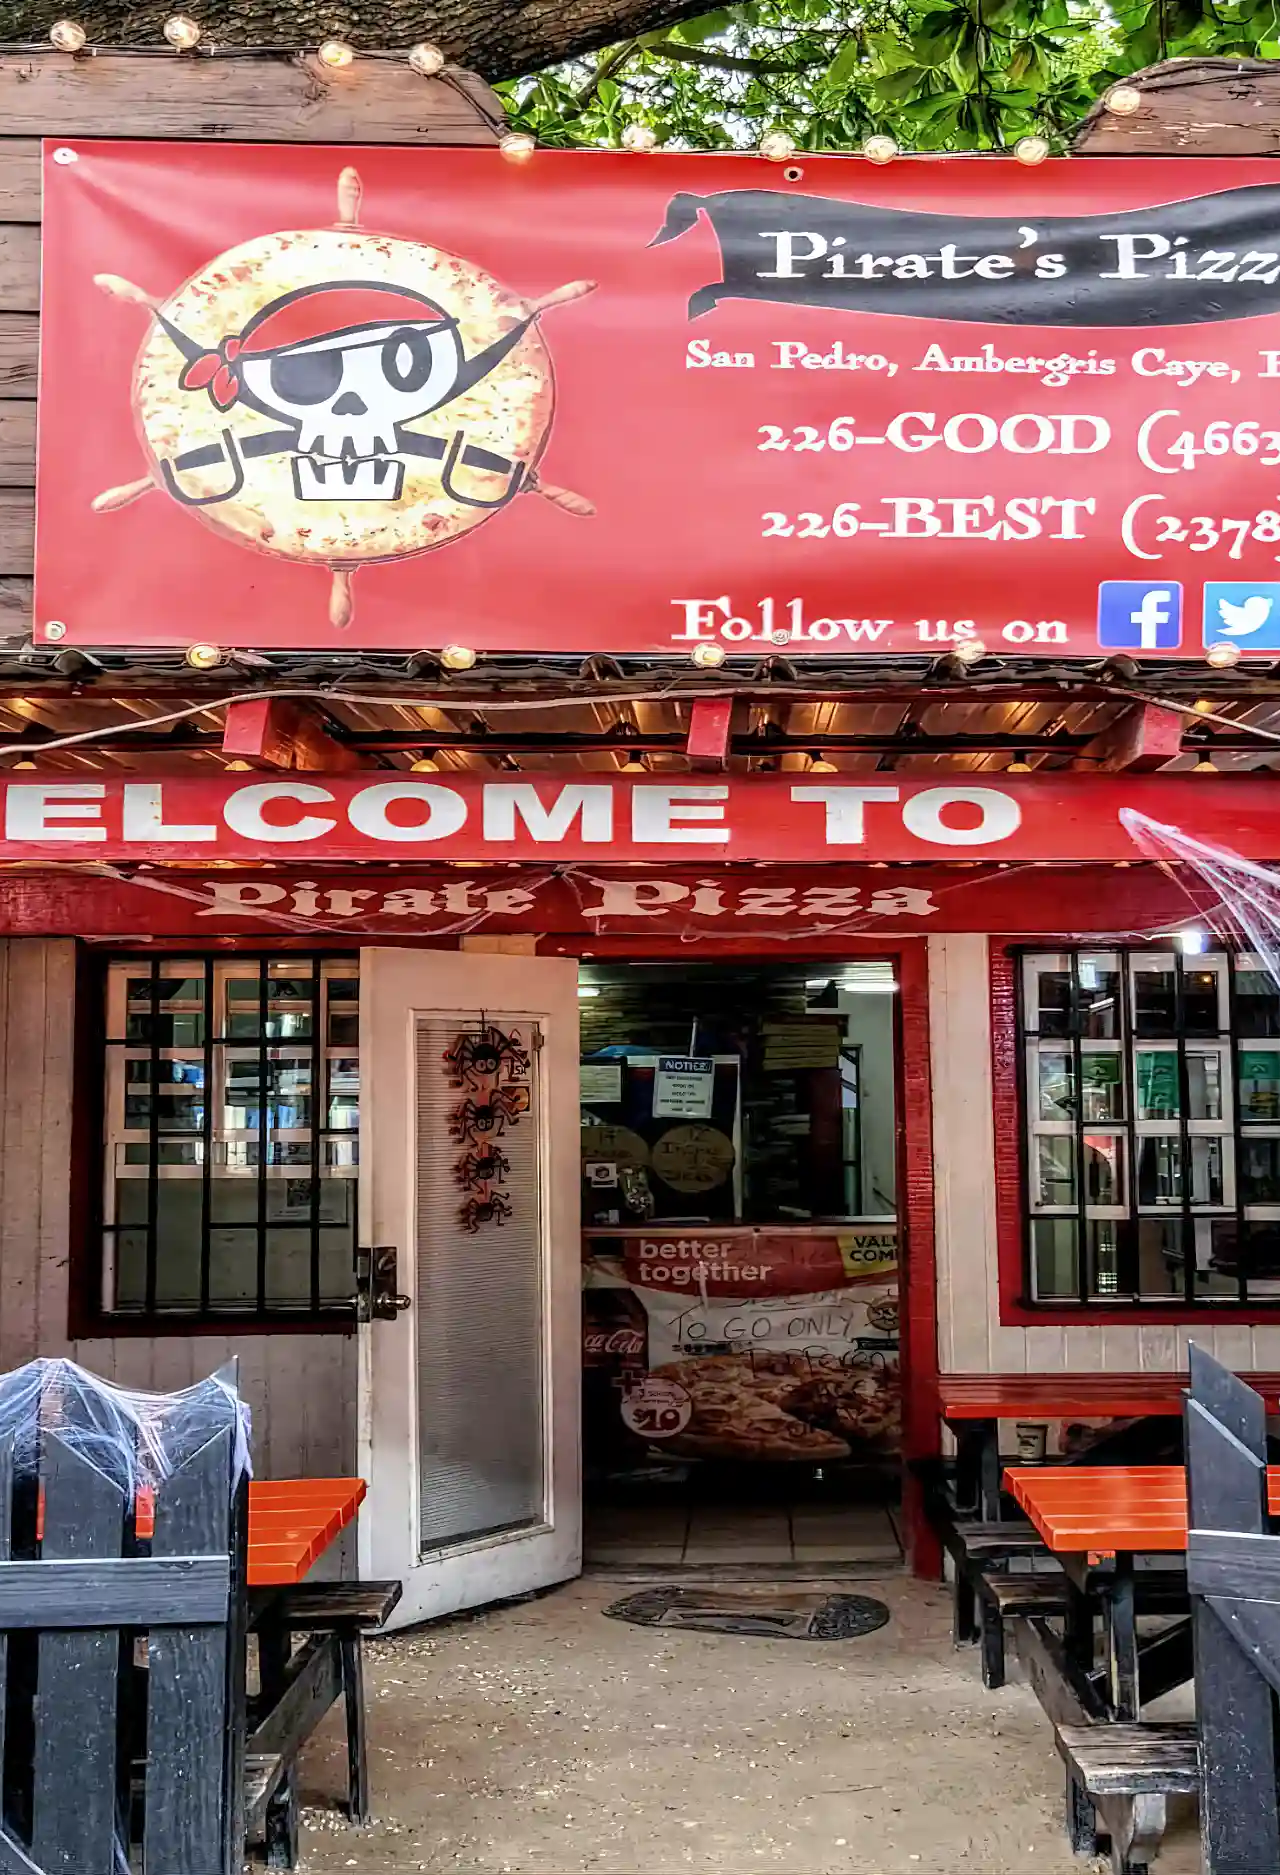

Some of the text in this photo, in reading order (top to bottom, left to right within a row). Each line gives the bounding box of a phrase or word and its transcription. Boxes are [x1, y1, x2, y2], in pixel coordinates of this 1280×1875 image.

[756, 226, 1067, 281] Pirate's
[685, 339, 755, 370] San
[770, 340, 899, 377] Pedro,
[912, 343, 1117, 387] Ambergris
[1131, 347, 1241, 387] Caye,
[757, 411, 1112, 455] 226-GOOD
[761, 495, 1097, 541] 226-BEST
[670, 596, 1070, 643] Follow us on
[789, 786, 1022, 846] TO
[194, 879, 940, 918] Pirate Pizza
[639, 1239, 732, 1259] better
[849, 1249, 898, 1262] COM
[853, 1236, 898, 1249] VAL
[638, 1261, 774, 1286] together
[724, 1316, 771, 1338] GO
[787, 1312, 854, 1338] ONLY
